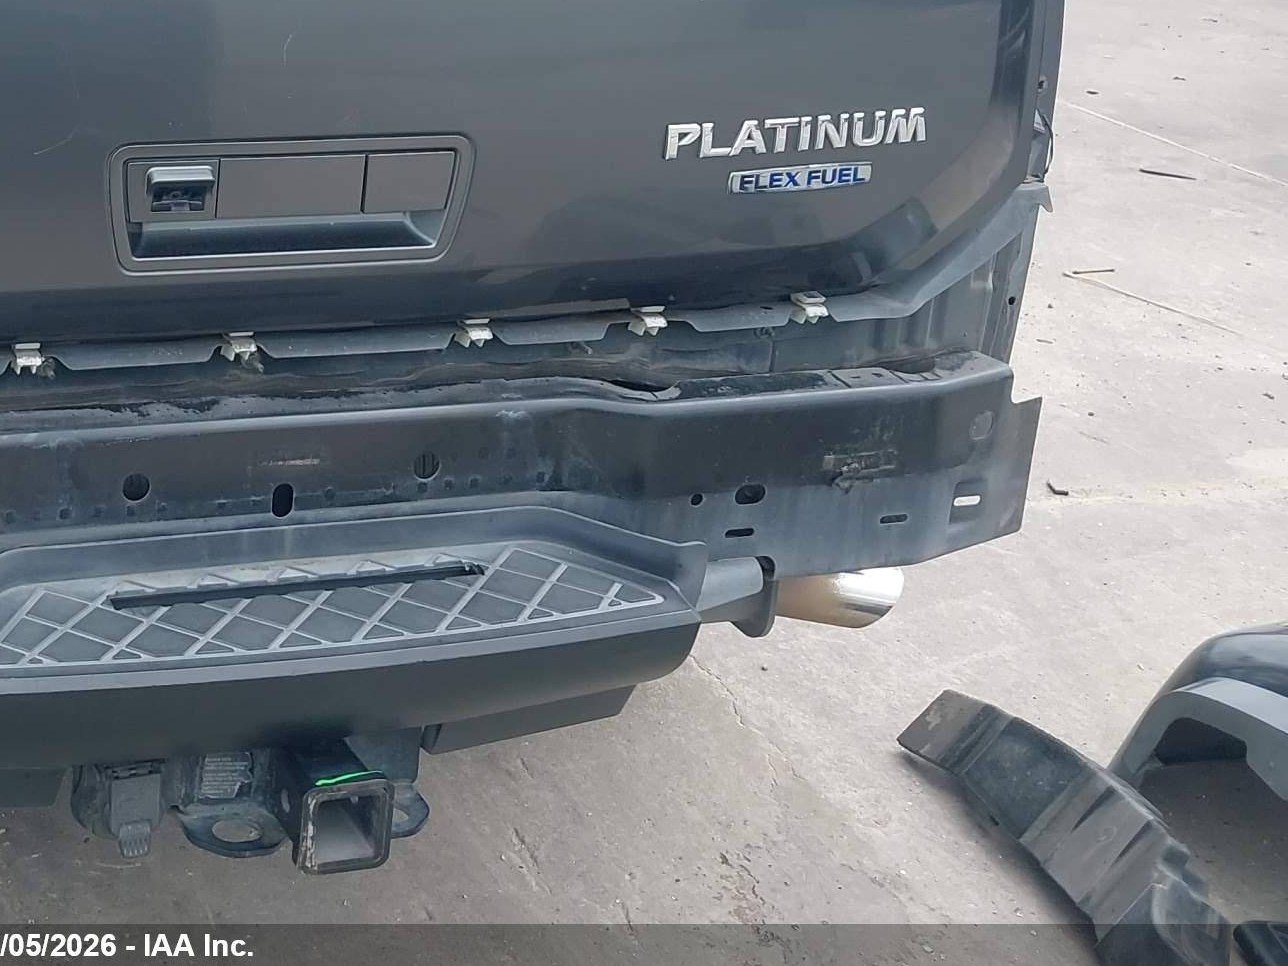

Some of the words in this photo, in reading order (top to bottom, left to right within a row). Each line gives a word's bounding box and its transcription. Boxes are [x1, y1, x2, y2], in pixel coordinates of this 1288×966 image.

[665, 107, 926, 160] PLATINUM
[738, 171, 801, 191] FLEX
[806, 166, 865, 185] FUEL
